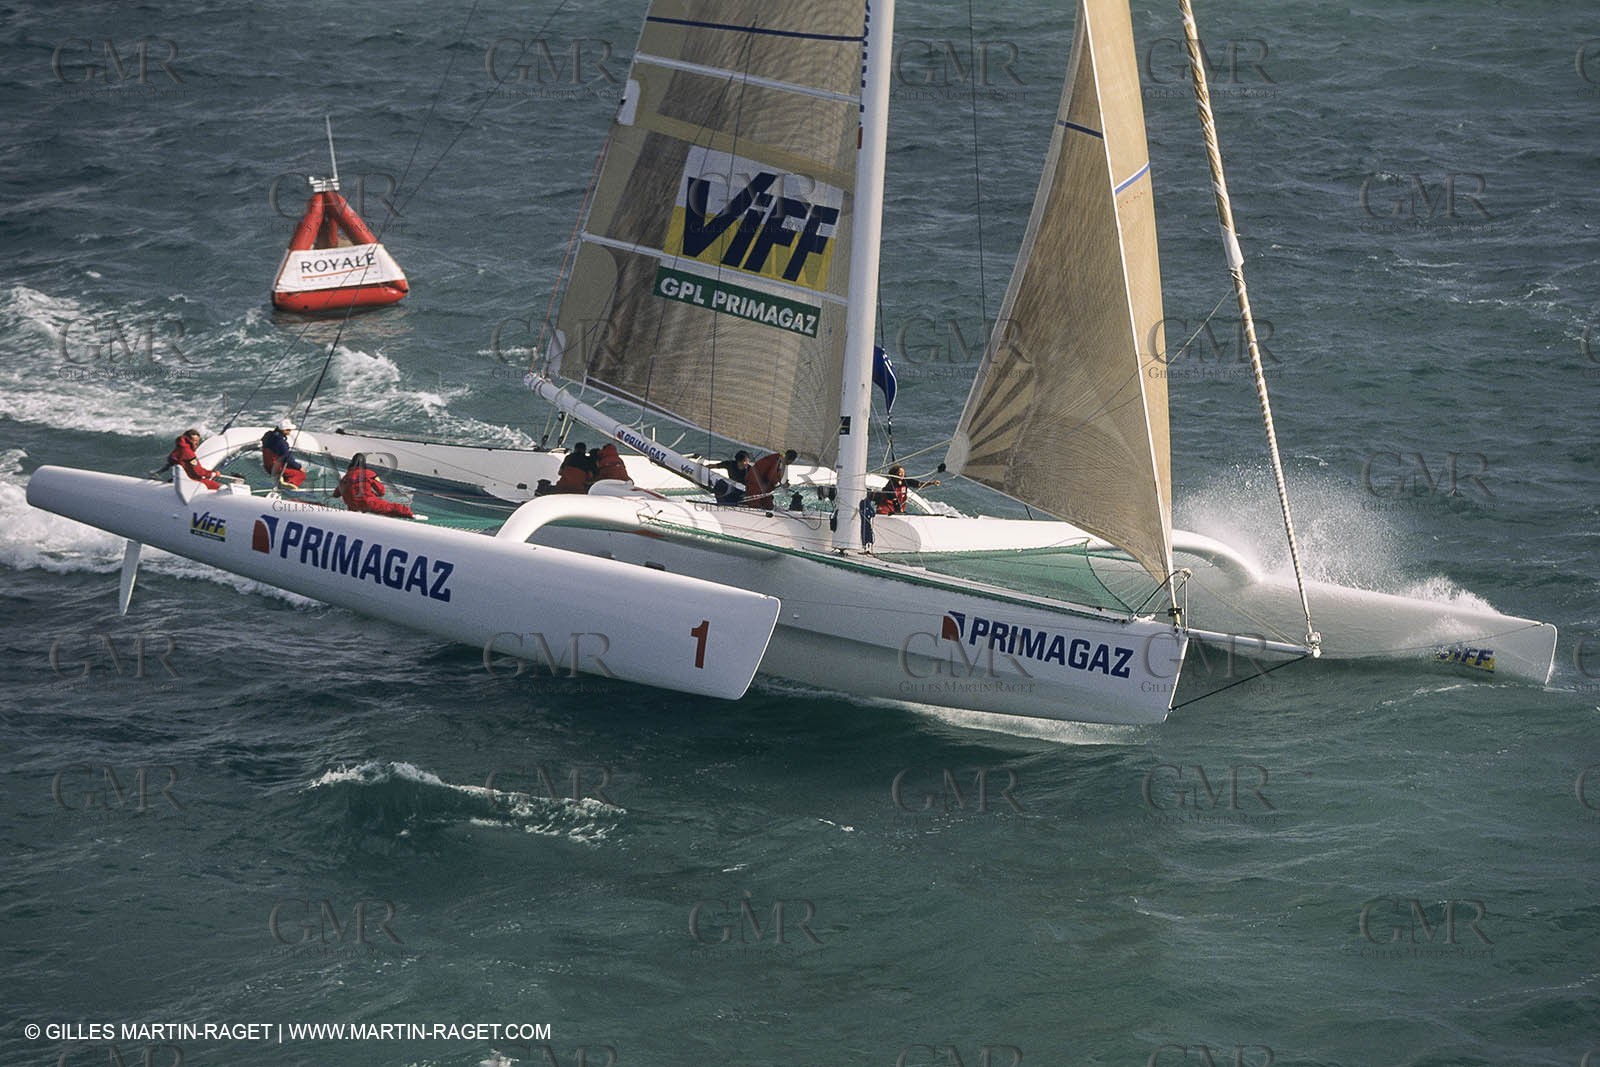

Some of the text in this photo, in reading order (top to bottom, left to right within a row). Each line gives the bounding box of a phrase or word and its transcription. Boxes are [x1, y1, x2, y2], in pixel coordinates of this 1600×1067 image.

[301, 252, 377, 273] ROYALE
[660, 277, 817, 335] GPL PRIMAGAZ
[280, 521, 454, 602] PRIMAGAZ
[690, 620, 710, 669] 1
[969, 616, 1134, 678] PRIMAGAZ
